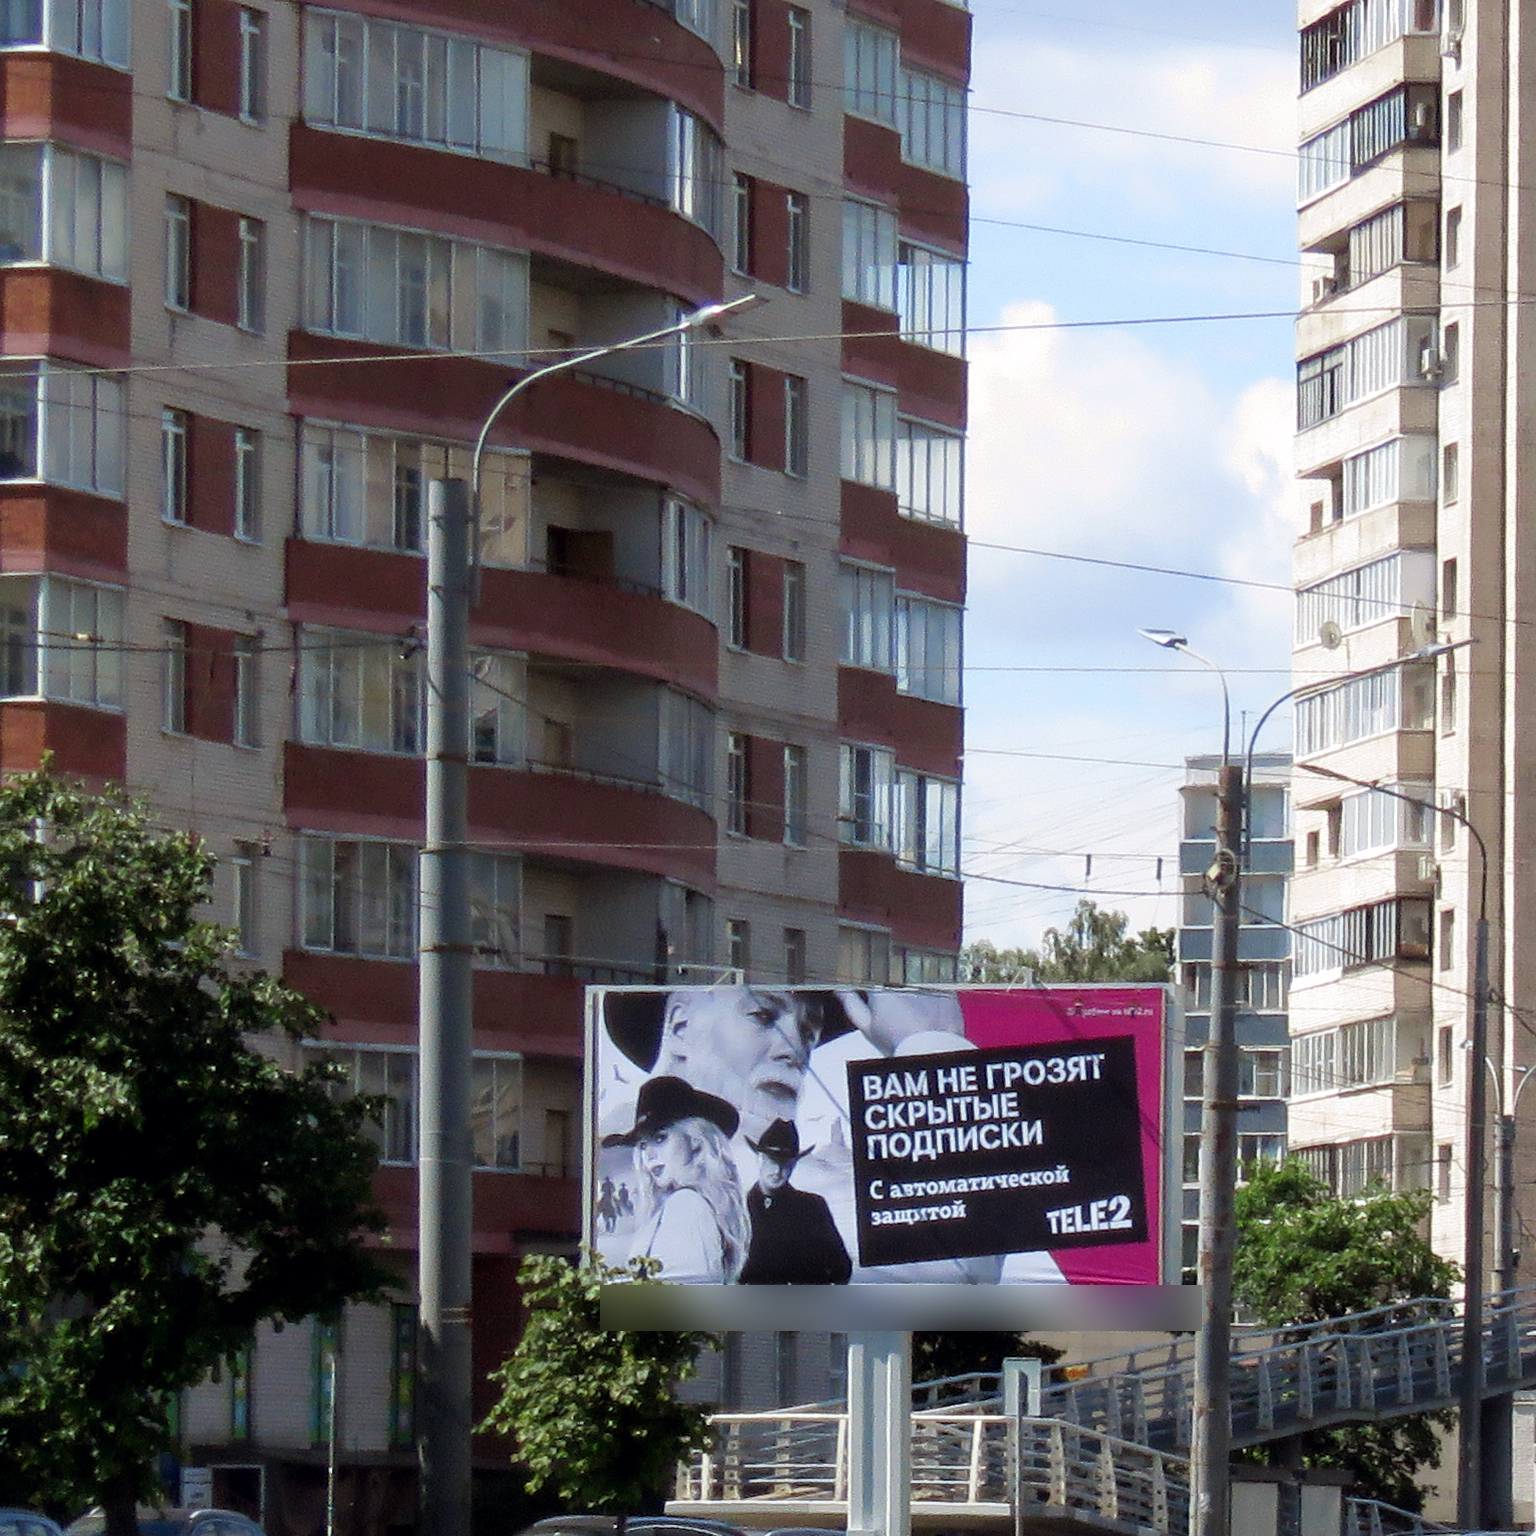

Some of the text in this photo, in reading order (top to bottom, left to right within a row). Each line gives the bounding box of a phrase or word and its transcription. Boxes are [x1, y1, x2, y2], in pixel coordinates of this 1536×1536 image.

[862, 1054, 1105, 1101] ВАМ НЕ ГРОЗЯТ
[864, 1092, 1020, 1130] СКРЫТЫЕ
[866, 1120, 1043, 1162] ПОДПИСКИ
[869, 1165, 1070, 1200] С автоматической
[871, 1200, 967, 1226] защитой
[1046, 1195, 1133, 1235] TELE2
